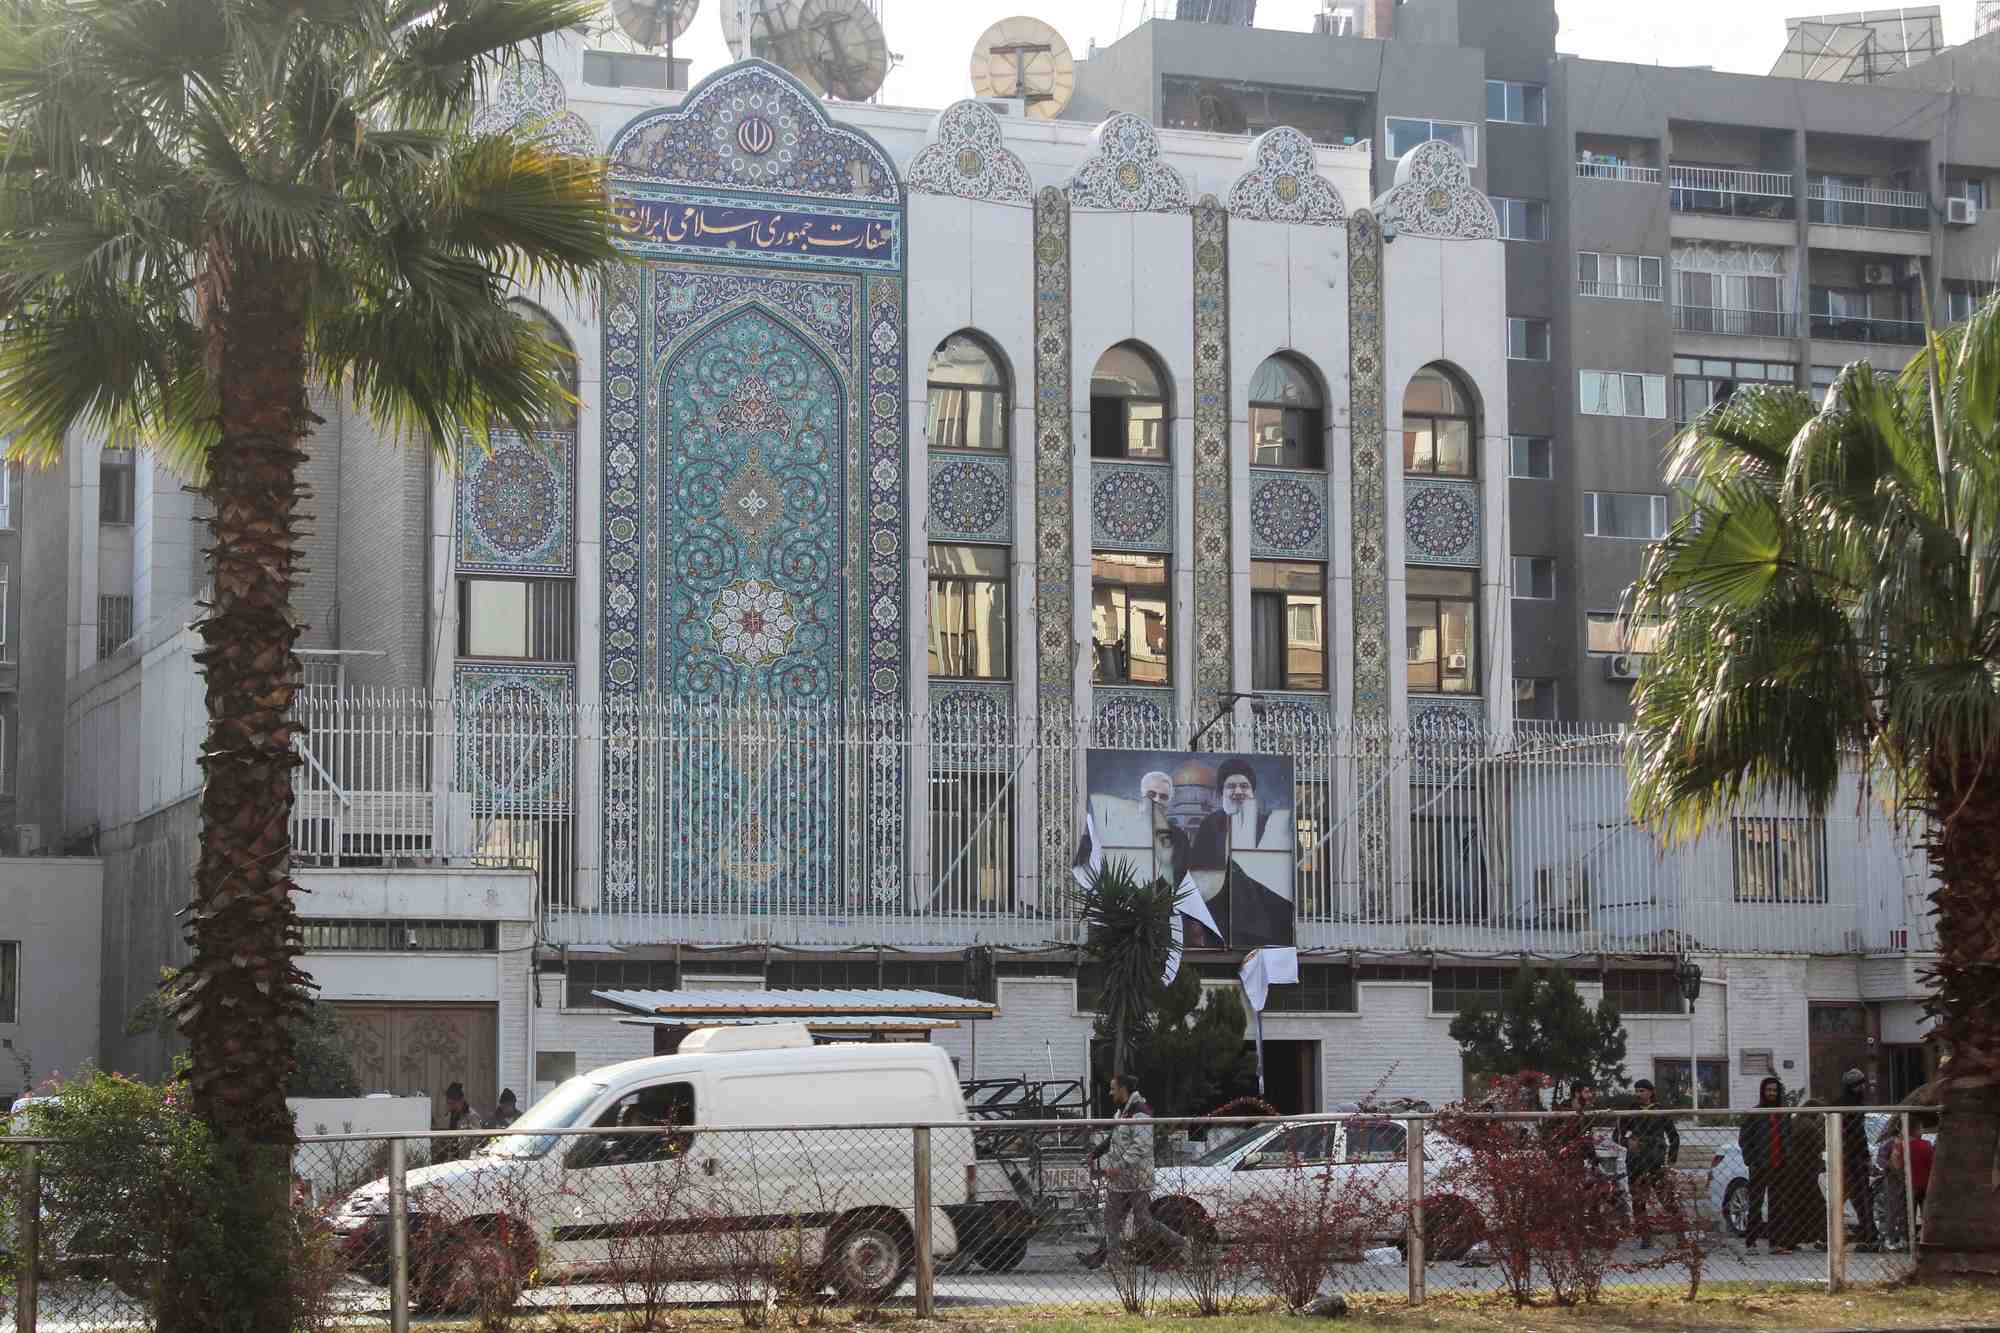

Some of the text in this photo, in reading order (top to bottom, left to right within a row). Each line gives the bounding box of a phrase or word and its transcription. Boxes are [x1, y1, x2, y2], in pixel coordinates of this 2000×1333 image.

[619, 205, 887, 252] سفارت جمهوری اسلامی ایران
